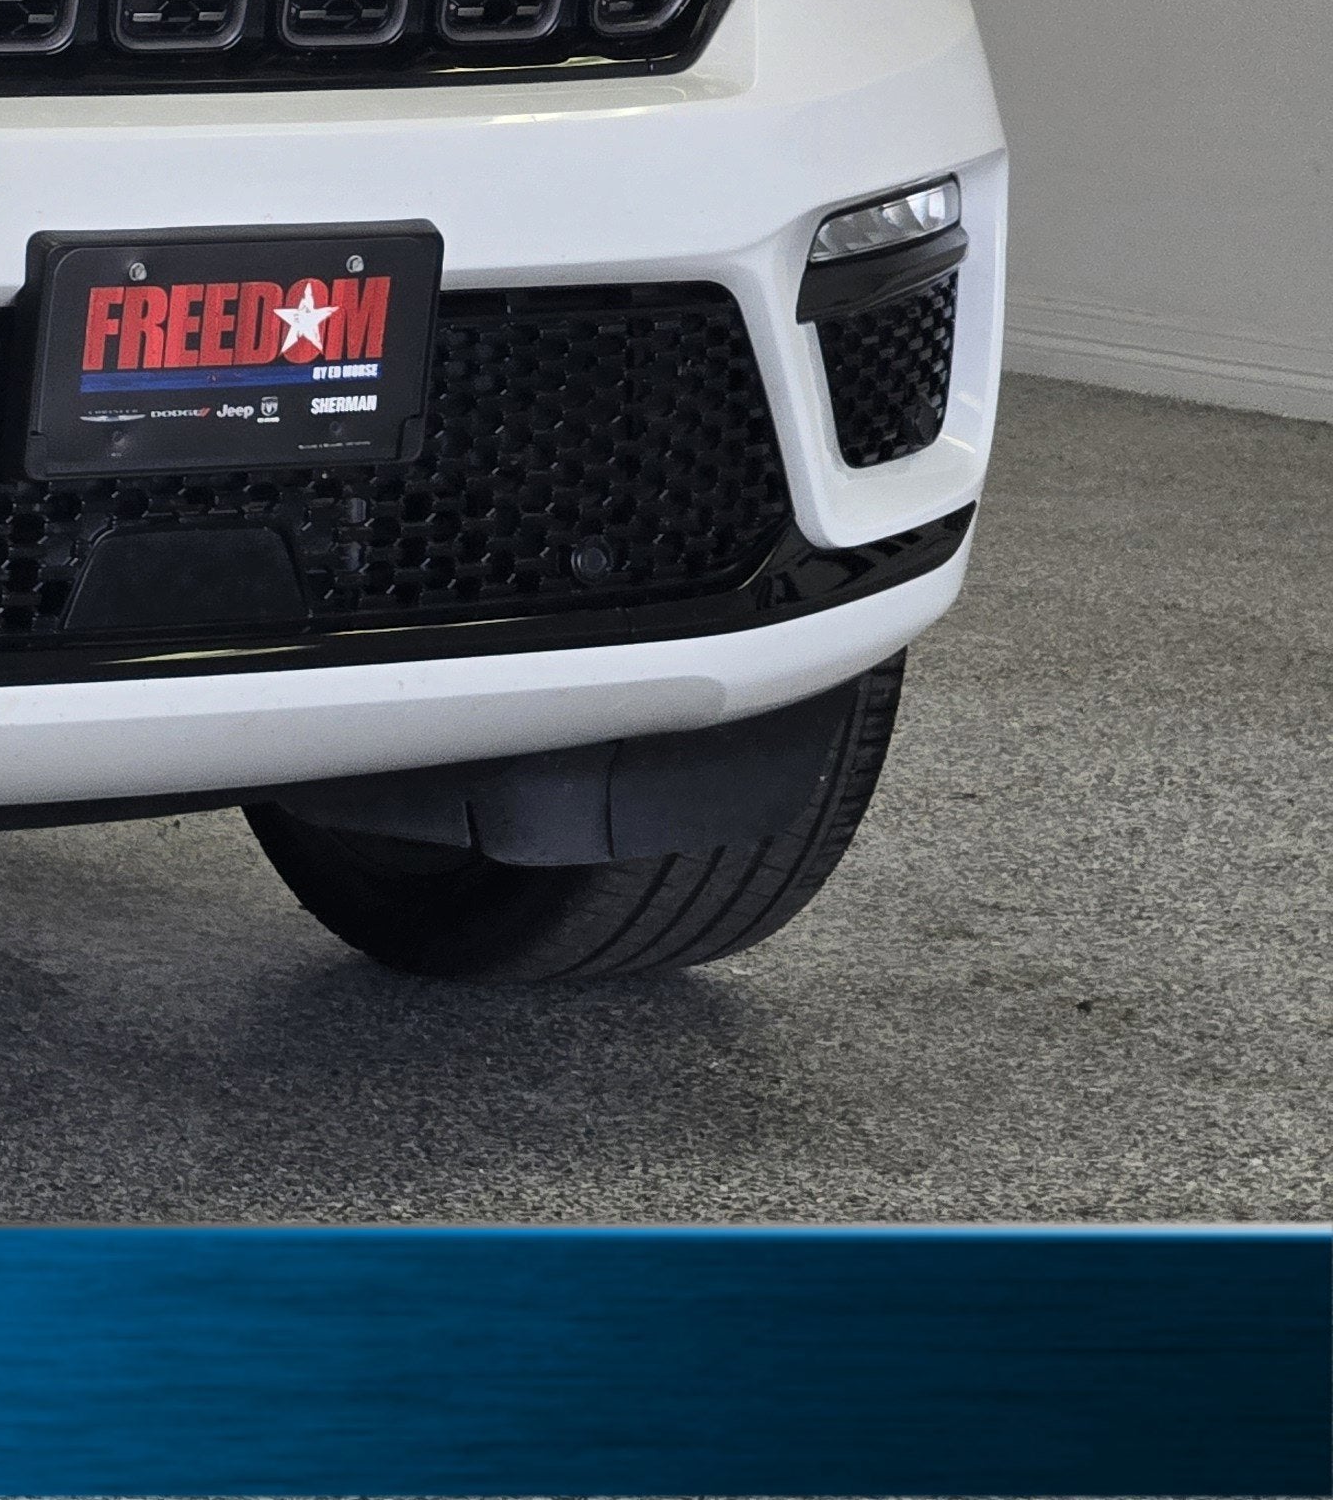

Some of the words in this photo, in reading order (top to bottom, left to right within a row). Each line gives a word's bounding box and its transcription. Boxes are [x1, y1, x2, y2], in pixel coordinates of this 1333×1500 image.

[82, 276, 391, 370] FREEDOM
[216, 403, 255, 420] Jeep
[310, 395, 377, 415] SHERMAN
